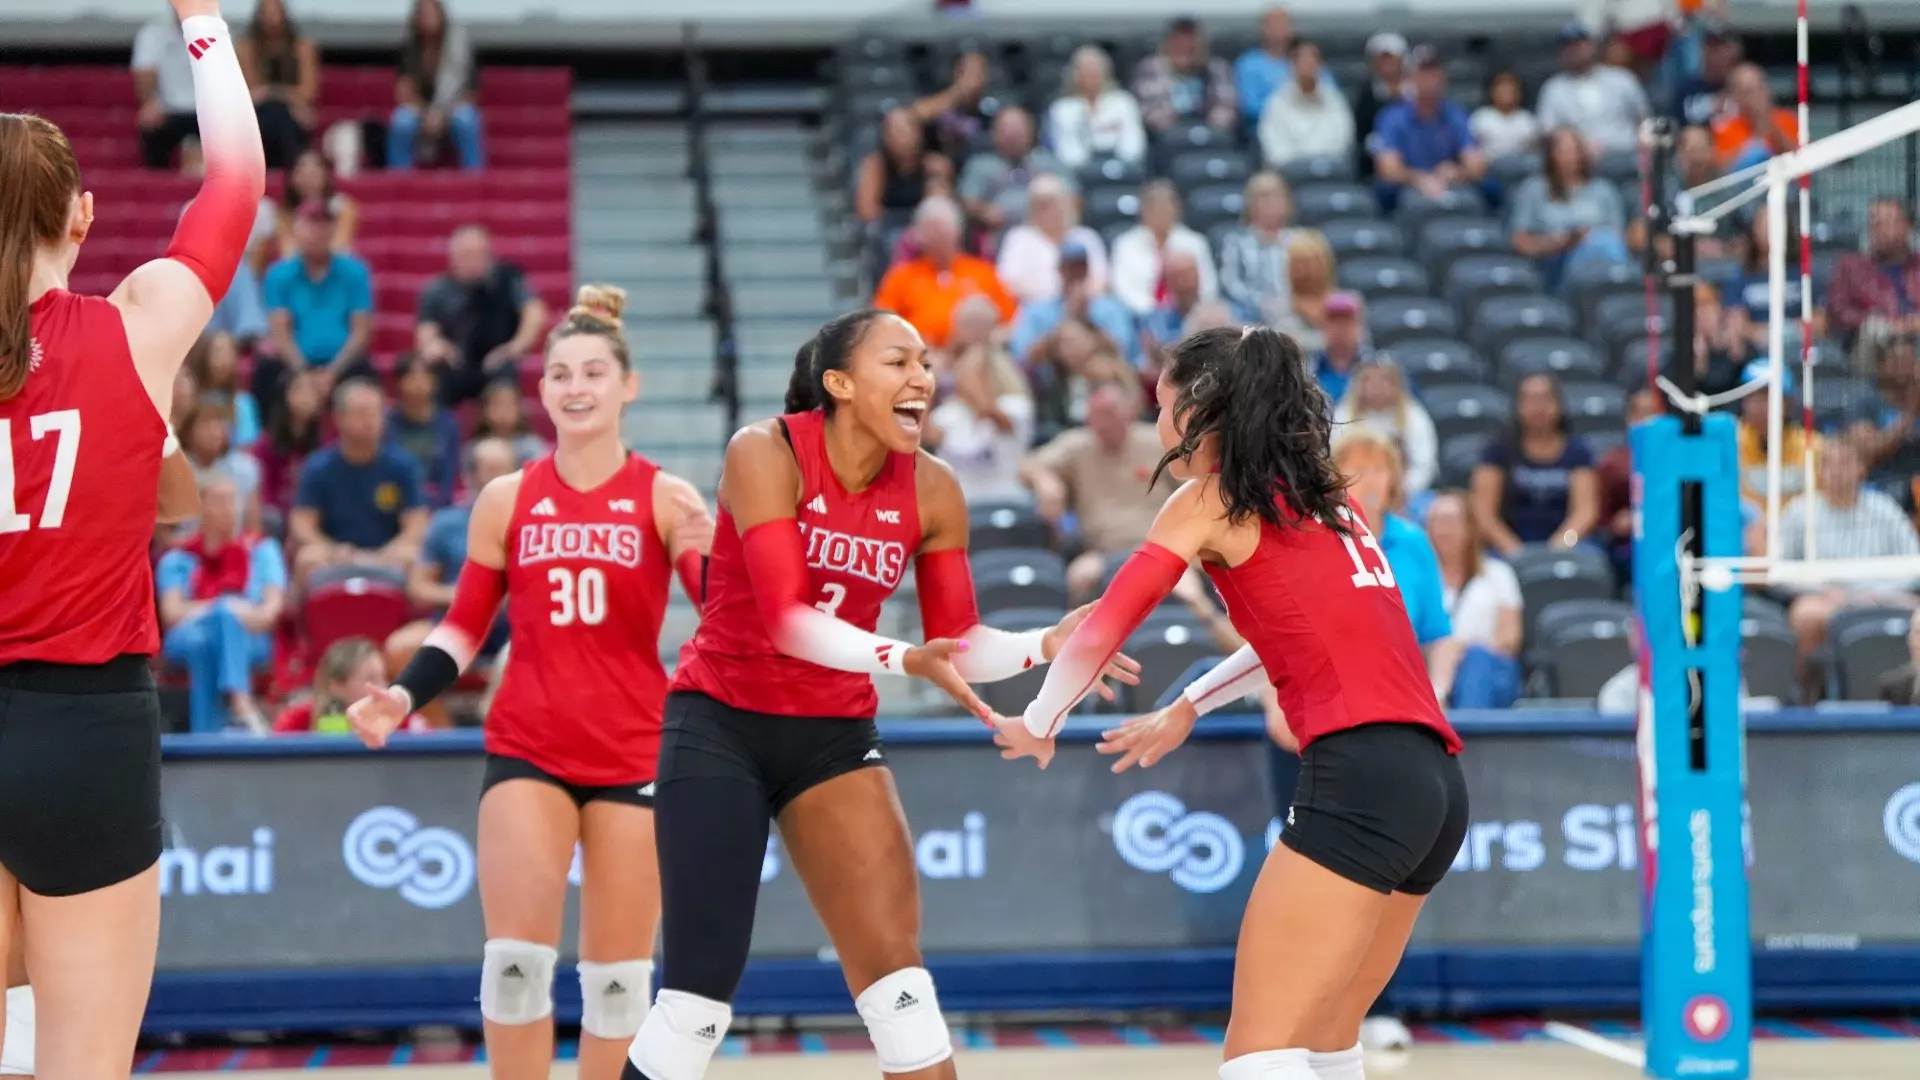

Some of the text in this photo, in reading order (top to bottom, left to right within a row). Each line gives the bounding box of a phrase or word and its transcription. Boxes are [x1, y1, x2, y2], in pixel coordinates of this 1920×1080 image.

[0, 408, 81, 534] 17
[518, 523, 641, 569] LIONS
[798, 521, 905, 589] IONS
[1312, 504, 1396, 588] 13
[548, 567, 607, 626] 30
